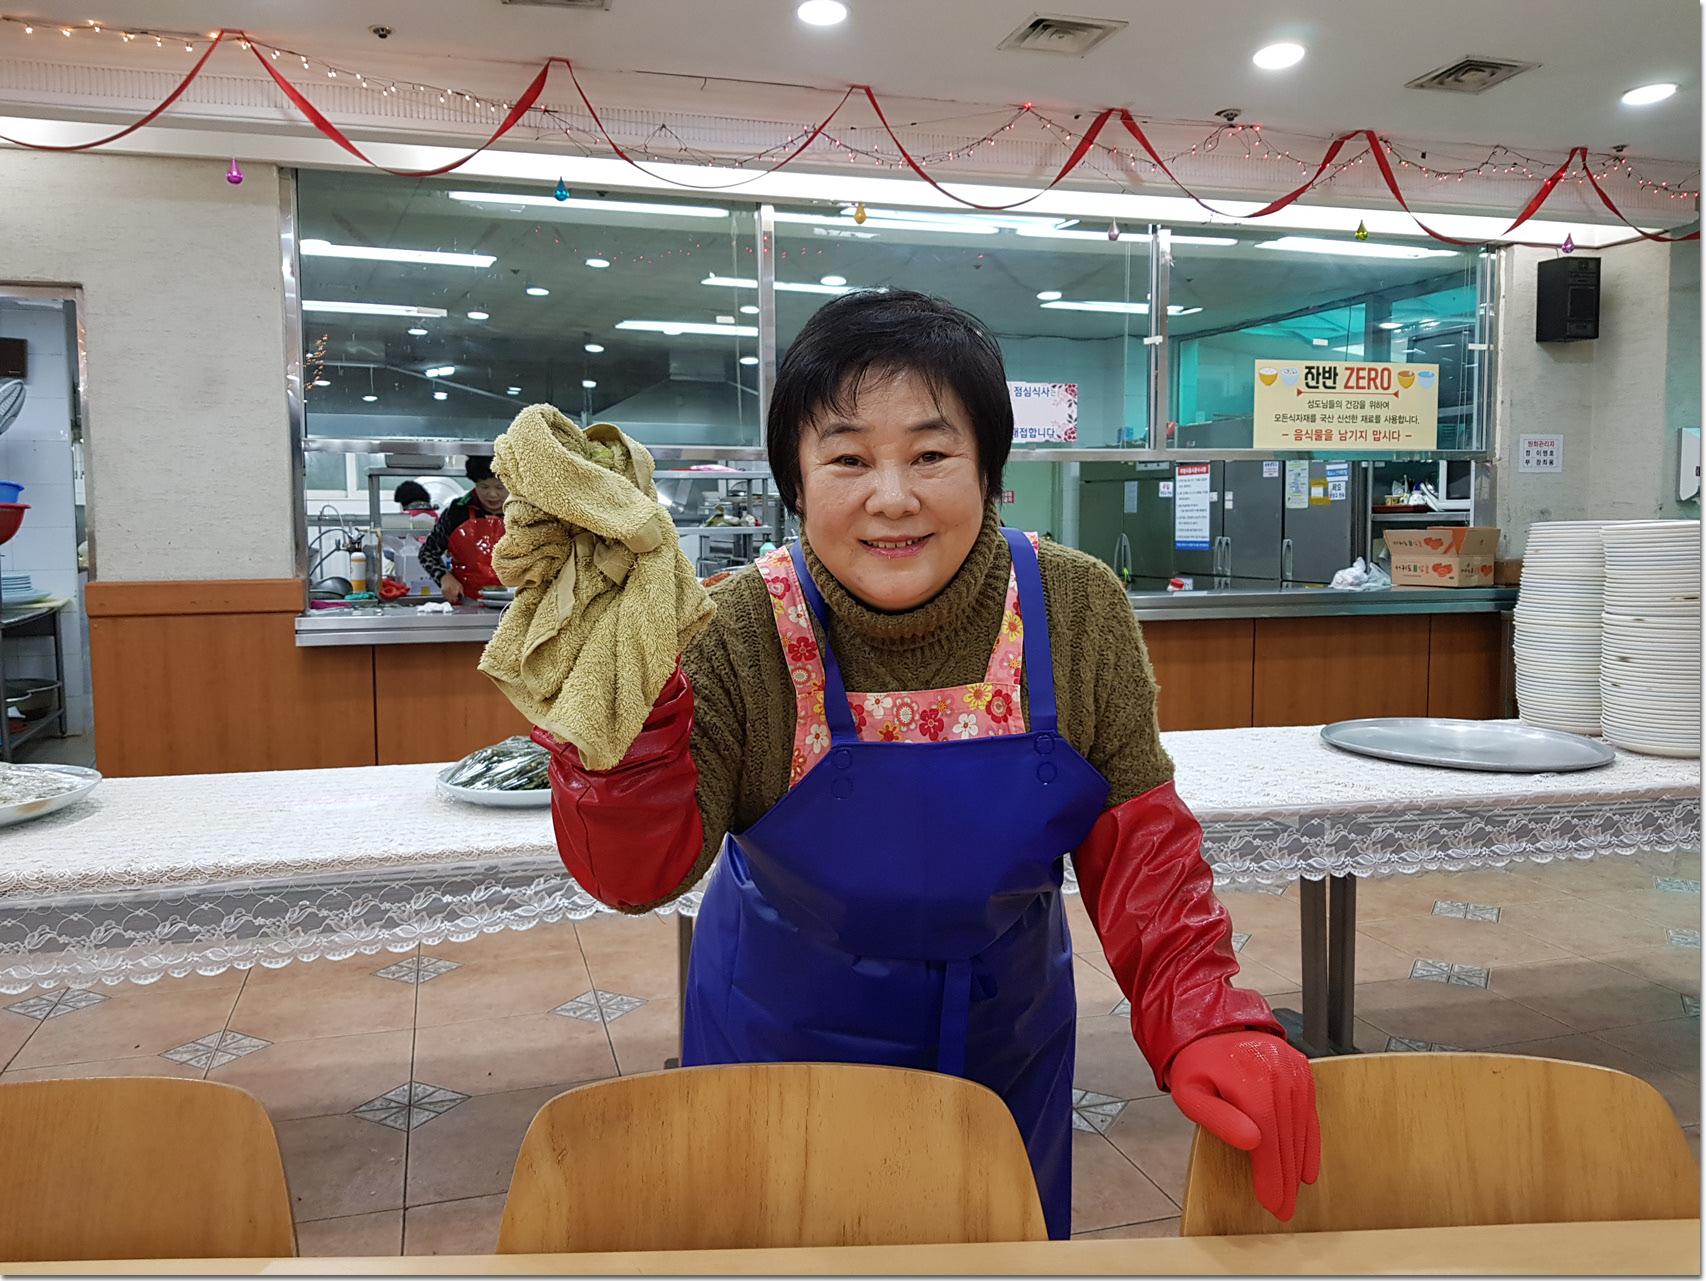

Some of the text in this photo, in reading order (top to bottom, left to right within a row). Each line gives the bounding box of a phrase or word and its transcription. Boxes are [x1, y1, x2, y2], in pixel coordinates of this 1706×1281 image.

[1304, 366, 1392, 390] 잔반 ZERO
[1307, 400, 1390, 410] 성도님들의 건강을 위하여
[1274, 413, 1420, 425] 모든식자재를 국산 신선한 재료를 사용합니다.
[1294, 429, 1401, 442] 음식물을 남기지 맙시다
